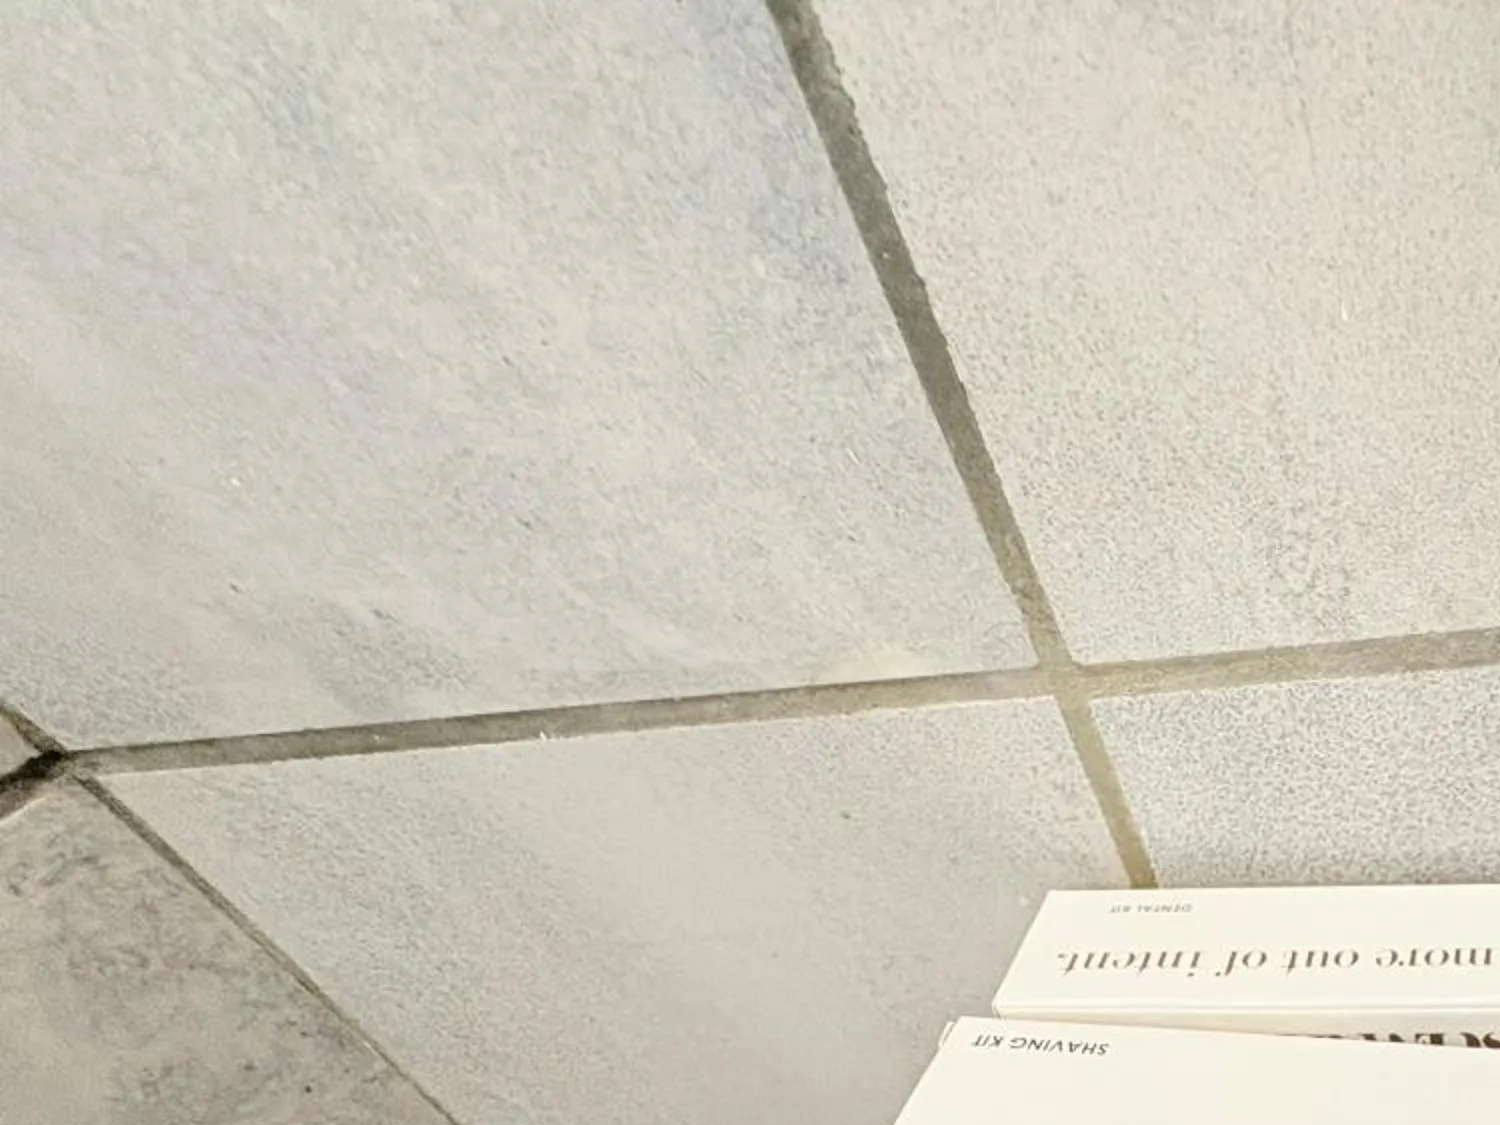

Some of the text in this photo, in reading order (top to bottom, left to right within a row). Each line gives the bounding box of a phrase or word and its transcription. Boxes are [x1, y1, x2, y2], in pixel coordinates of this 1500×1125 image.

[1056, 949, 1202, 978] intent.
[1215, 949, 1269, 976] of
[1281, 949, 1360, 975] out
[1375, 947, 1494, 972] more
[970, 1033, 1109, 1056] SHAVING KIT
